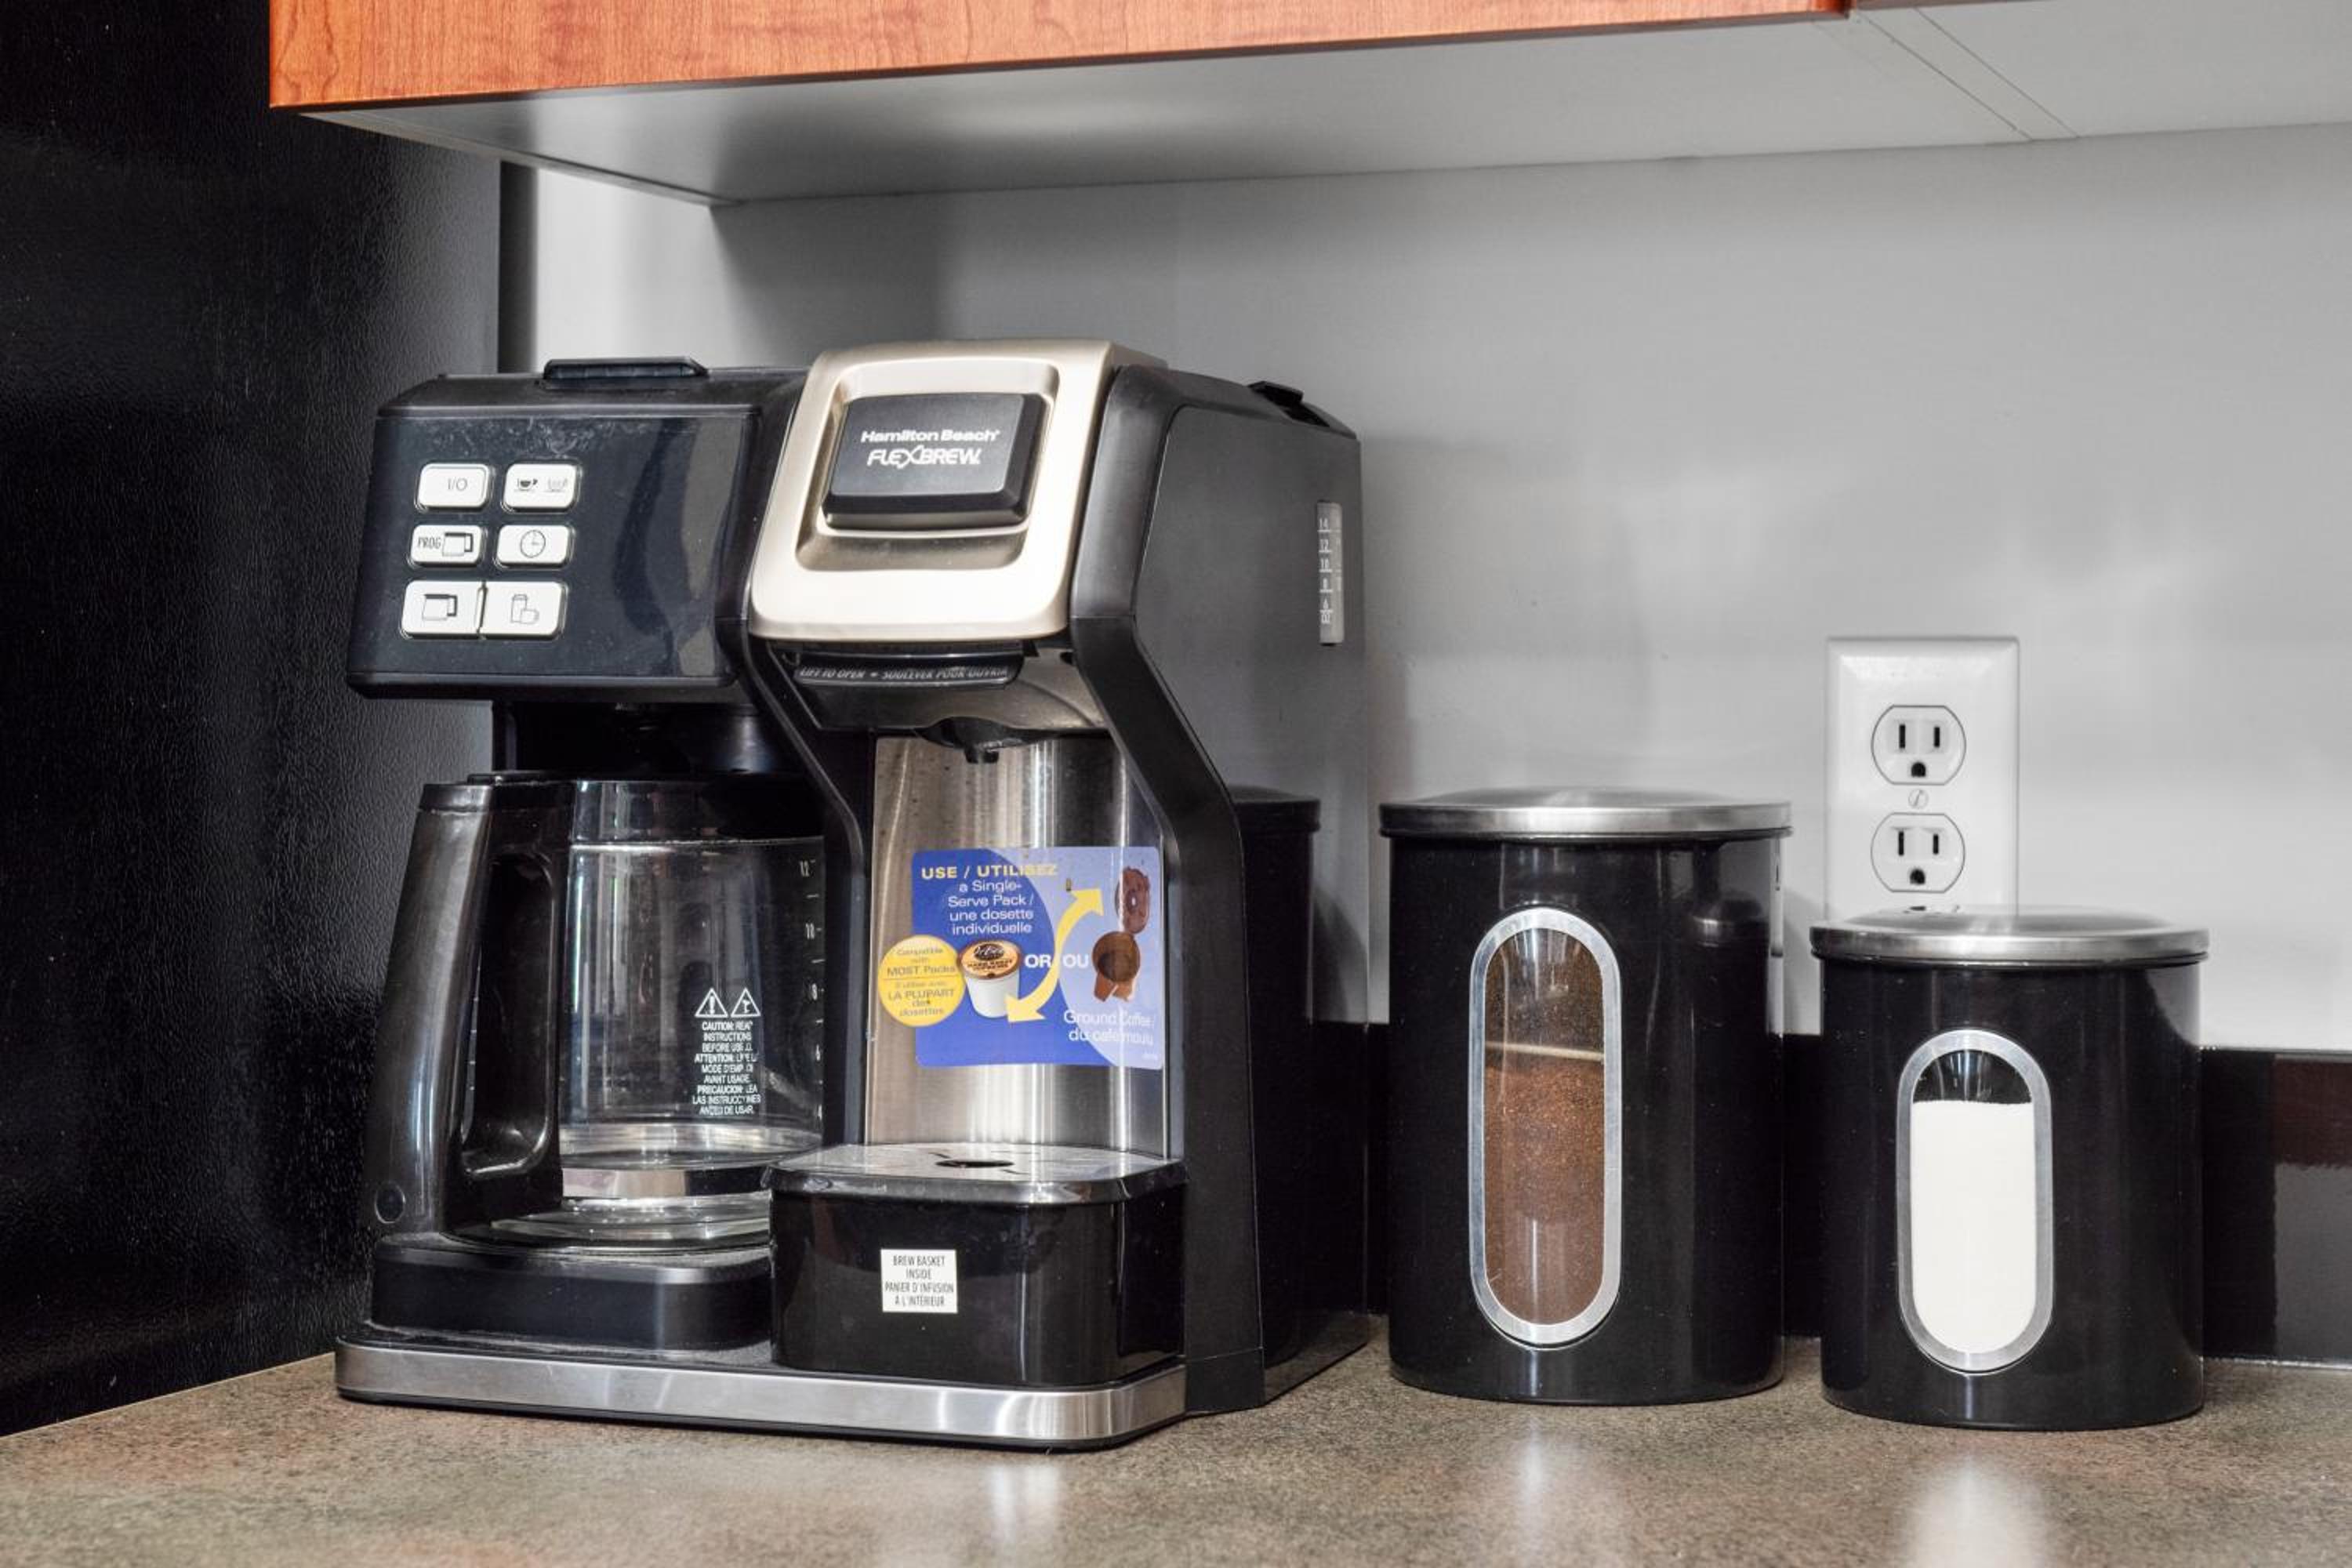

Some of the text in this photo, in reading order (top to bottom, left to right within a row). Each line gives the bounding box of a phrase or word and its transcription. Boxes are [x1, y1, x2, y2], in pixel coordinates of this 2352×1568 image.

[861, 430, 939, 443] Hamilton
[866, 445, 982, 469] FLEXBREW
[417, 536, 441, 550] PROG
[921, 866, 958, 880] USE
[959, 880, 1022, 895] a Single-
[948, 896, 989, 907] Serve
[993, 895, 1026, 906] Pack
[949, 909, 1034, 921] une dosette
[953, 923, 1033, 935] individuelle
[1025, 954, 1051, 968] OR
[1062, 953, 1089, 969] OU
[887, 966, 920, 976] MOST
[888, 989, 955, 1001] LA PLUPART
[1064, 1009, 1117, 1025] Ground
[1069, 1028, 1088, 1042] du
[893, 1255, 946, 1266] BREW BASKET
[906, 1269, 931, 1279] INSIDE
